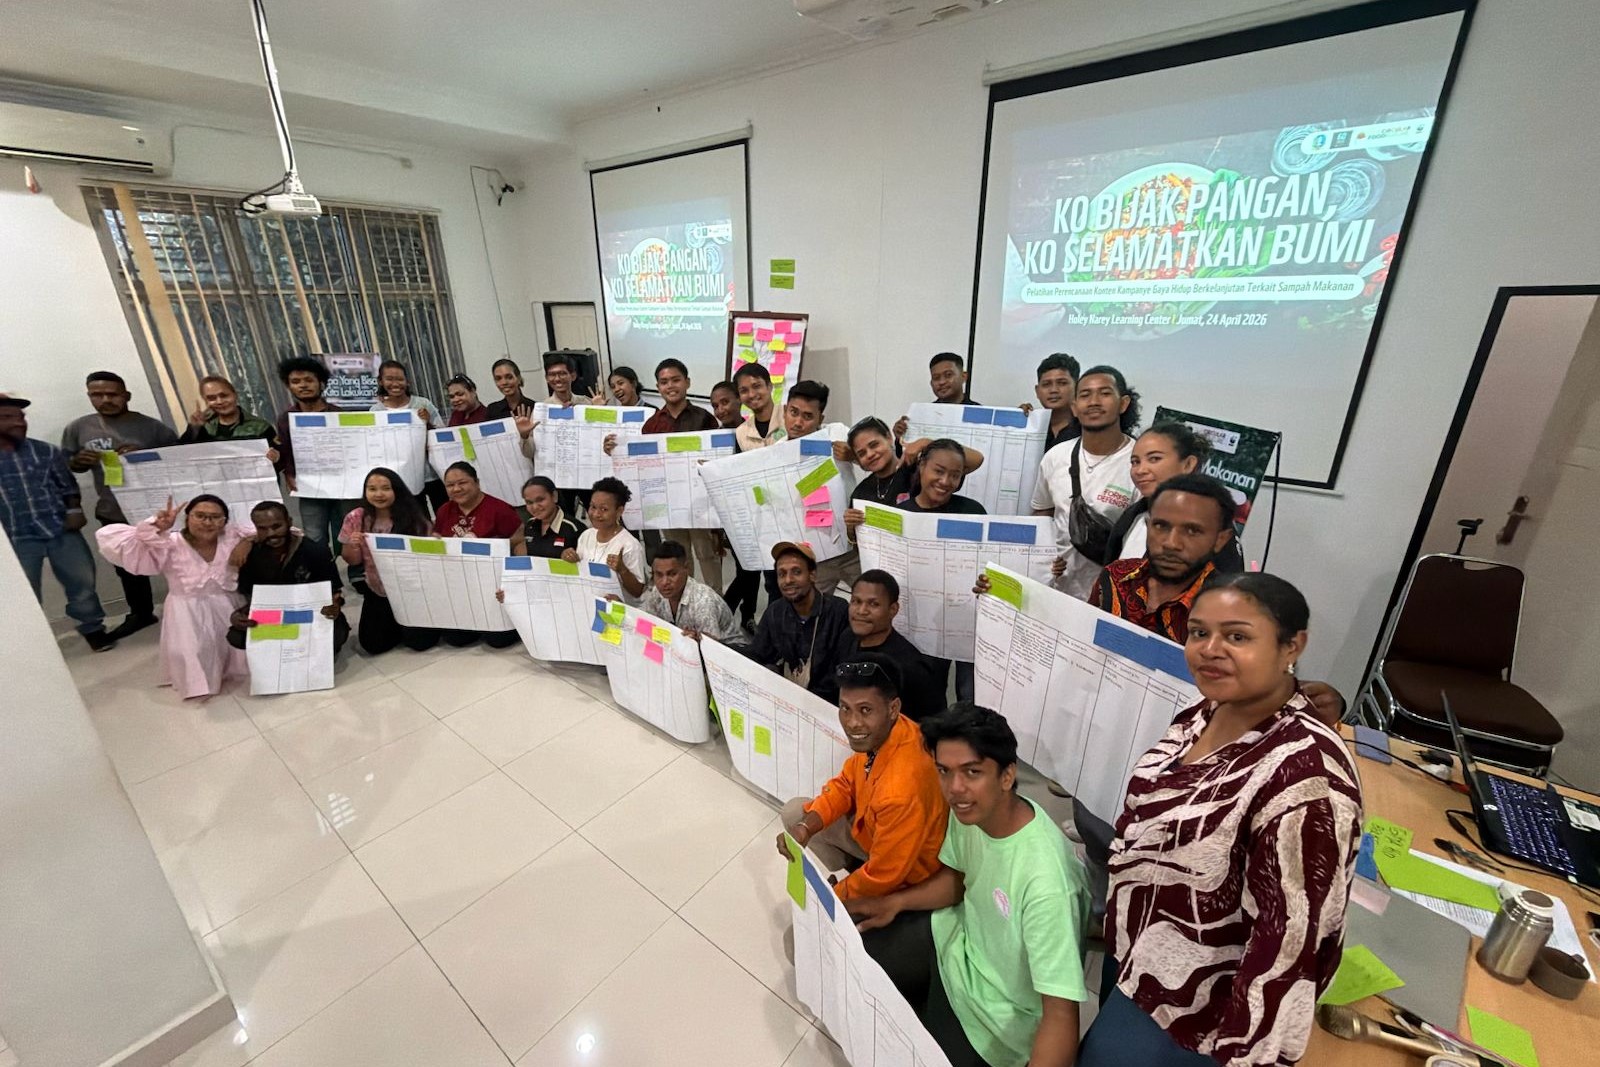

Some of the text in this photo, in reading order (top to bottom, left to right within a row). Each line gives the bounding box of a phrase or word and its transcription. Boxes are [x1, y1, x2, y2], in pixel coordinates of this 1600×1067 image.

[1053, 171, 1339, 234] KO BIJAK PANGAN,
[1023, 219, 1375, 275] KO SELAMATKAN BUMI
[617, 253, 631, 275] KO
[631, 251, 660, 274] BIJAK
[610, 273, 725, 298] KO SELAMATKAN BUMI
[1026, 281, 1354, 297] Pelatihan Perencanaan Konten Kampanye Gaya Hidup Berkelanjutan Terkait Sampah Makanan
[1068, 314, 1268, 327] Holey Narey Learning Center Jumat, 24 April 2026
[340, 375, 360, 388] Yang
[361, 375, 378, 385] Bisa
[323, 387, 378, 397] Kita Lakukan?
